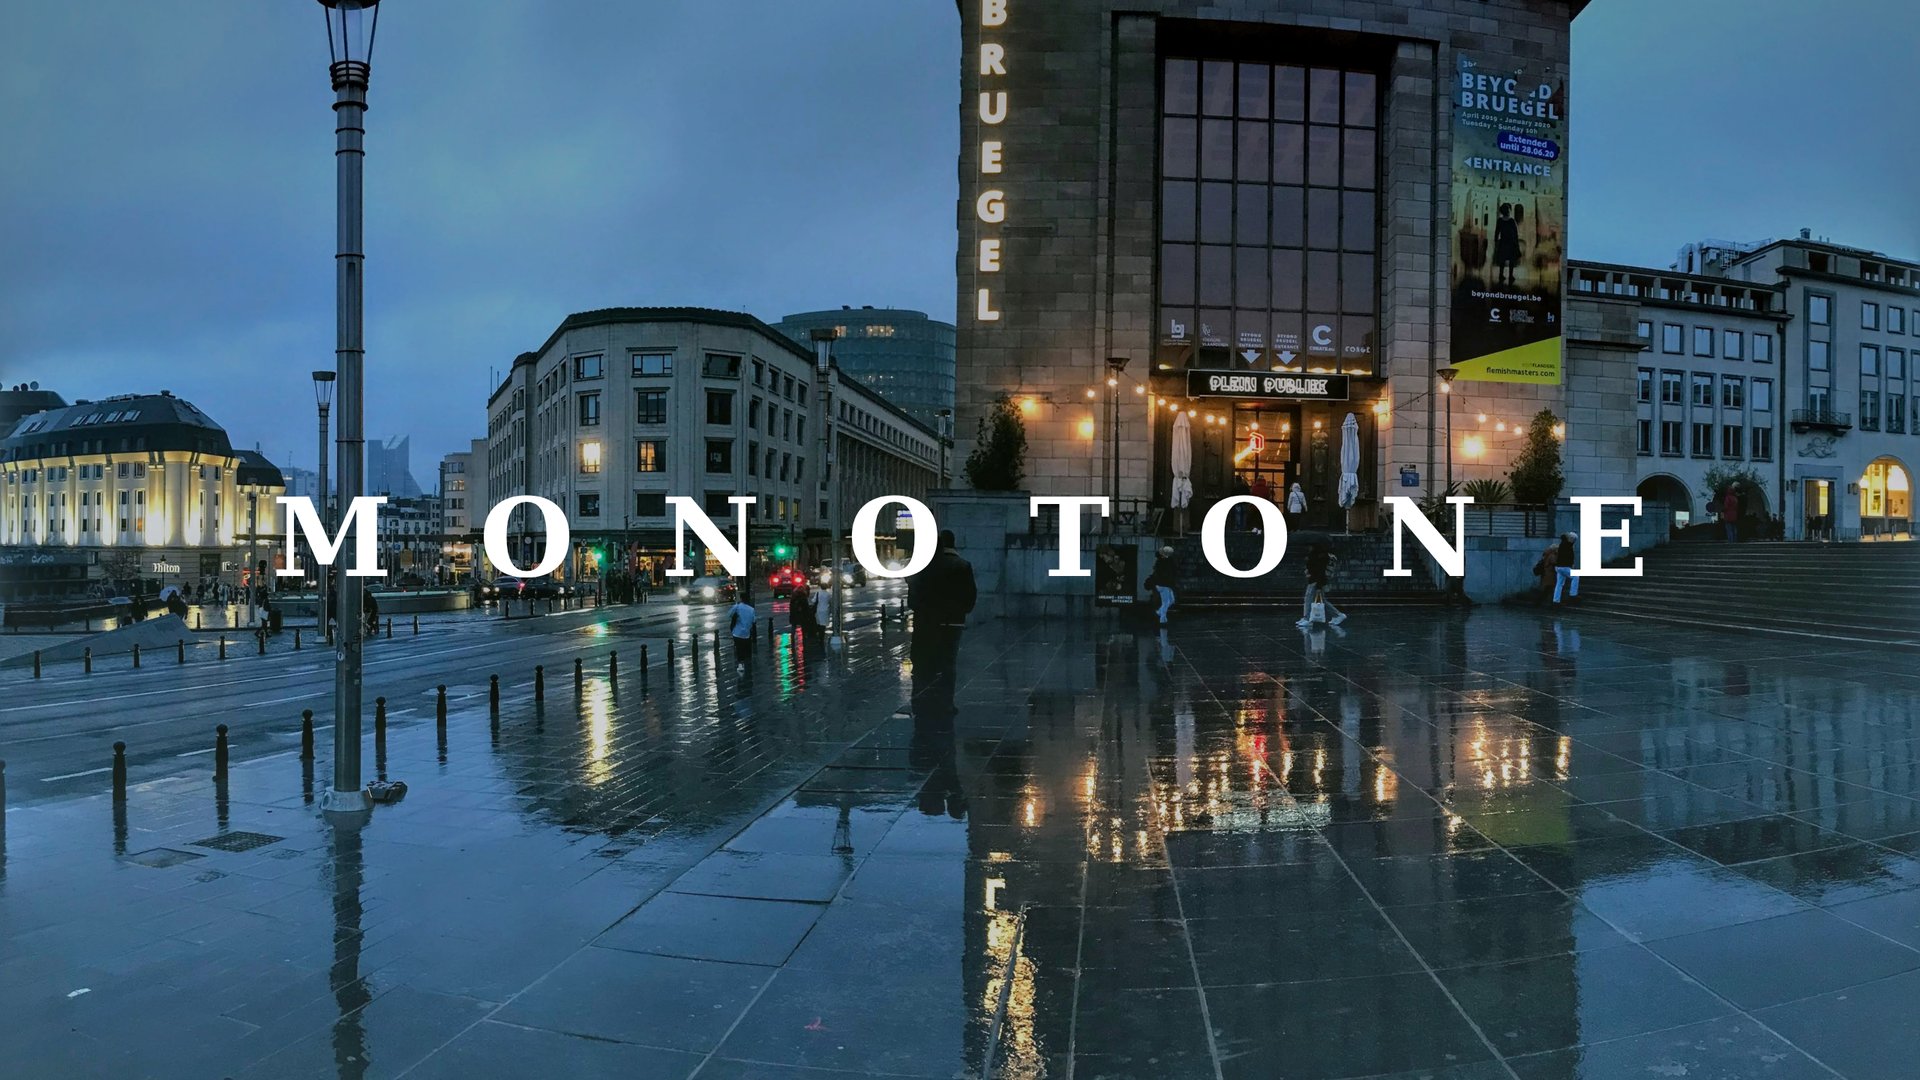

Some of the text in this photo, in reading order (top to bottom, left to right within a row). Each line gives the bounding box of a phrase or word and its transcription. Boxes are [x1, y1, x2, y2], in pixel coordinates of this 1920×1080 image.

[1461, 72, 1552, 100] BEYOD
[1461, 91, 1559, 120] BRUEGEL
[1461, 118, 1491, 129] Tuesday
[1498, 123, 1524, 134] Sunday
[1462, 111, 1480, 120] April
[1481, 114, 1498, 122] 2019
[1504, 117, 1533, 128] January
[1534, 121, 1551, 129] 2020
[1508, 134, 1548, 149] Extended
[1500, 142, 1555, 159] until 28.06.20
[976, 0, 1008, 321] BRUEGEL
[1473, 157, 1551, 177] ENTRANCE
[1471, 289, 1542, 302] beyondbruegel.be
[1486, 366, 1555, 377] flemishmasters.com
[1209, 375, 1258, 392] PLEIN
[152, 561, 181, 573] Hilton
